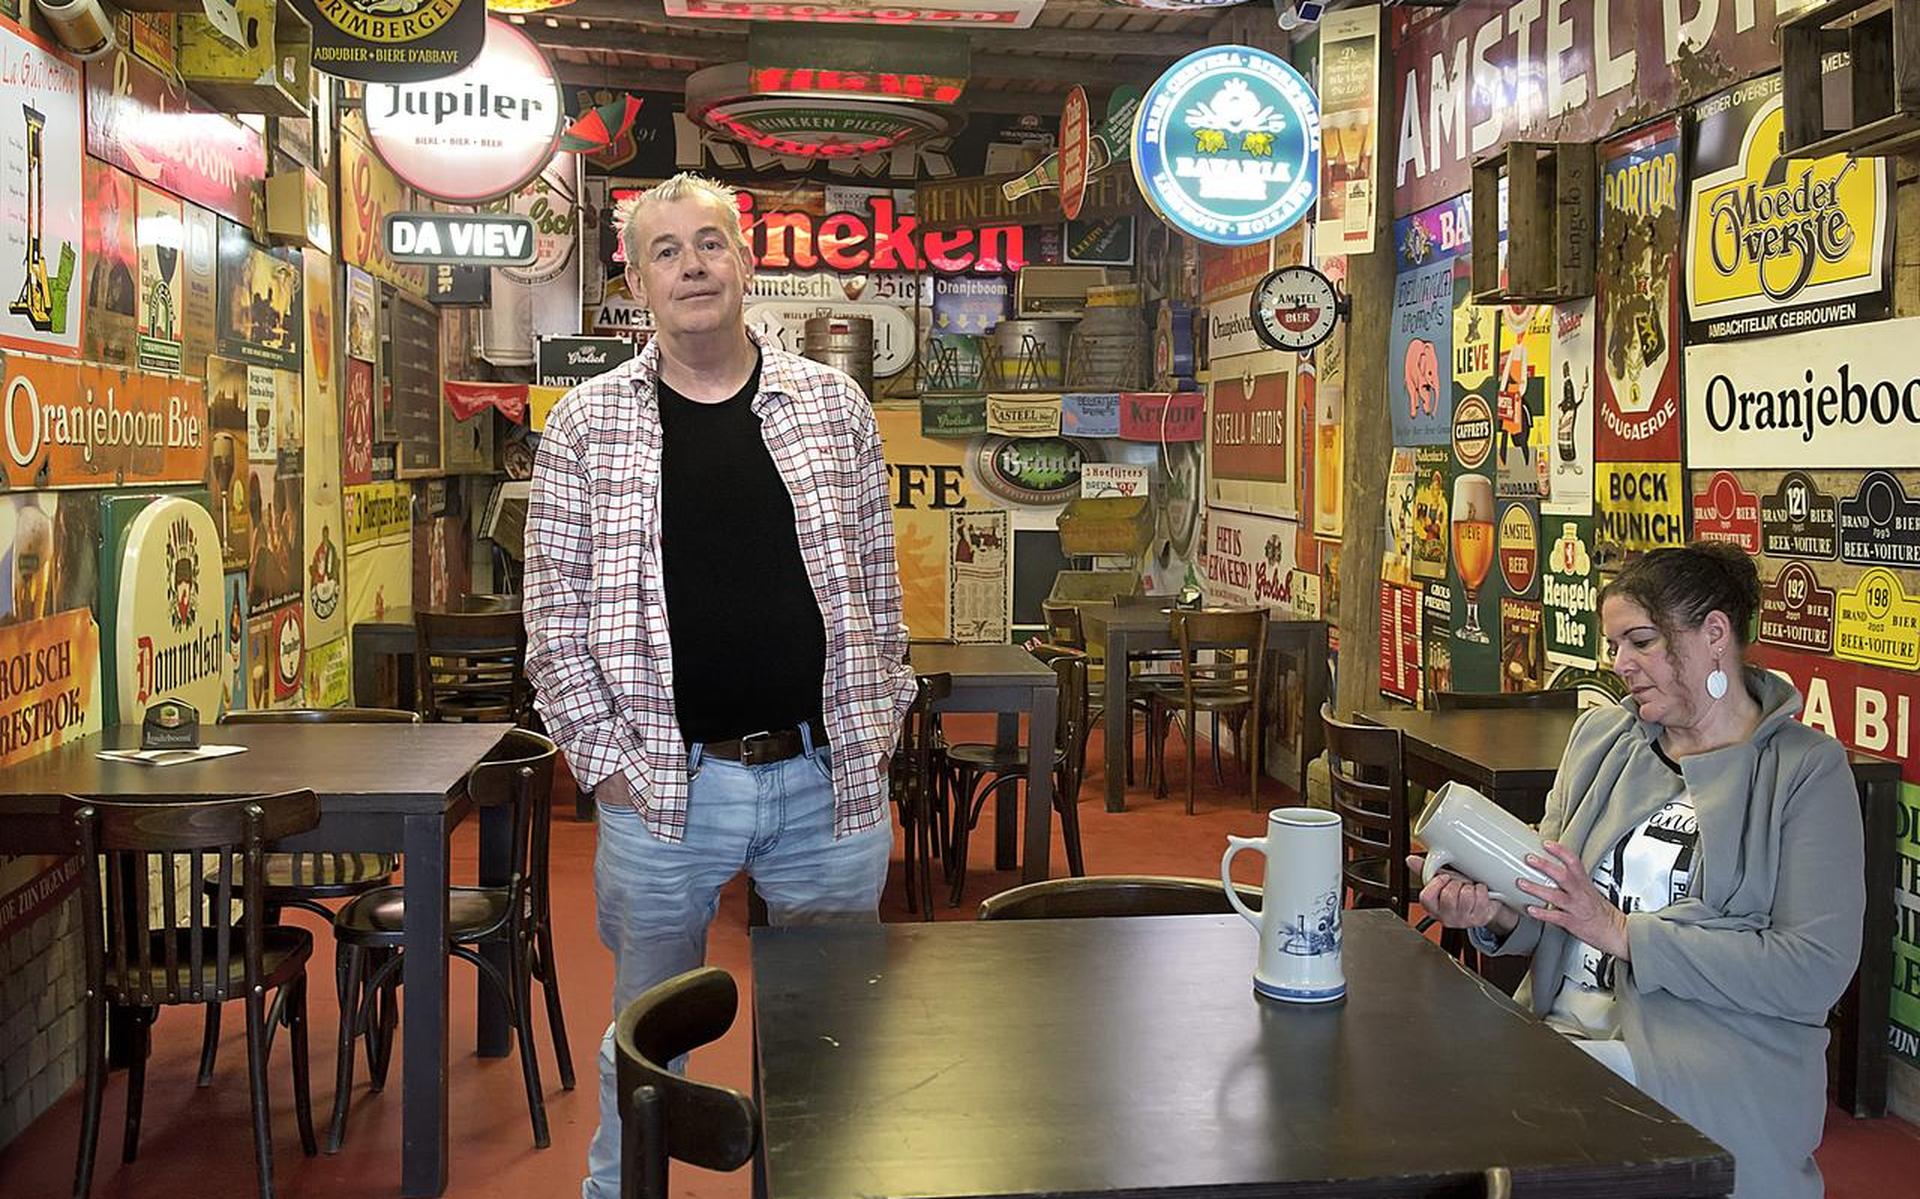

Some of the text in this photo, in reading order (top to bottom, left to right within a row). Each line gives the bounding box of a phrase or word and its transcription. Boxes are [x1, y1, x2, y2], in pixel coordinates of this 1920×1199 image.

[316, 0, 455, 39] RIMBERGE
[384, 83, 542, 125] Jupiler
[1397, 0, 1636, 188] AMSTEL
[1696, 77, 1783, 122] MOEDER OVERSTE
[752, 115, 835, 130] HEINEKEN
[1711, 157, 1858, 234] Moeder
[391, 220, 442, 255] DA
[449, 223, 529, 257] VIEV
[611, 188, 1031, 273] ineken
[1711, 204, 1856, 301] Overste
[936, 279, 1008, 298] Oranjeboom
[1276, 293, 1318, 305] AMSTEL
[1283, 312, 1310, 324] BIER
[1708, 303, 1857, 338] AMBACHTELIJK GEBROUWEN
[567, 350, 607, 365] Grolsch
[1456, 343, 1489, 375] LIEVE
[1705, 363, 1920, 443] Oranjeboo
[5, 374, 163, 467] Oranjeboom
[1214, 408, 1283, 446] STELLA ARTOIS
[1455, 420, 1489, 440] CAFFREY'S
[1610, 472, 1669, 503] BOCK
[1787, 486, 1807, 516] 121
[1601, 510, 1681, 545] MUNICH
[1694, 507, 1757, 521] BRAND BIER
[1762, 509, 1835, 523] BRAND BIER
[1841, 515, 1870, 529] BRAND
[1503, 523, 1532, 538] AMSTEL
[1768, 534, 1833, 554] BEEK-VOITURE
[1508, 556, 1529, 575] BEER
[1843, 541, 1920, 561] BEEK-VOITURE
[1254, 560, 1294, 605] Grolsch
[1542, 573, 1598, 617] Hengelo
[1787, 578, 1805, 600] 192
[1867, 587, 1889, 608] 198
[1763, 599, 1830, 617] BRAND BIER
[1842, 608, 1918, 628] BRAND BIER
[1554, 610, 1587, 648] Bier
[1761, 621, 1829, 645] BEEK-VOITURE
[1840, 633, 1915, 658] BEEK-VOITURE
[136, 619, 222, 705] Dommelsch
